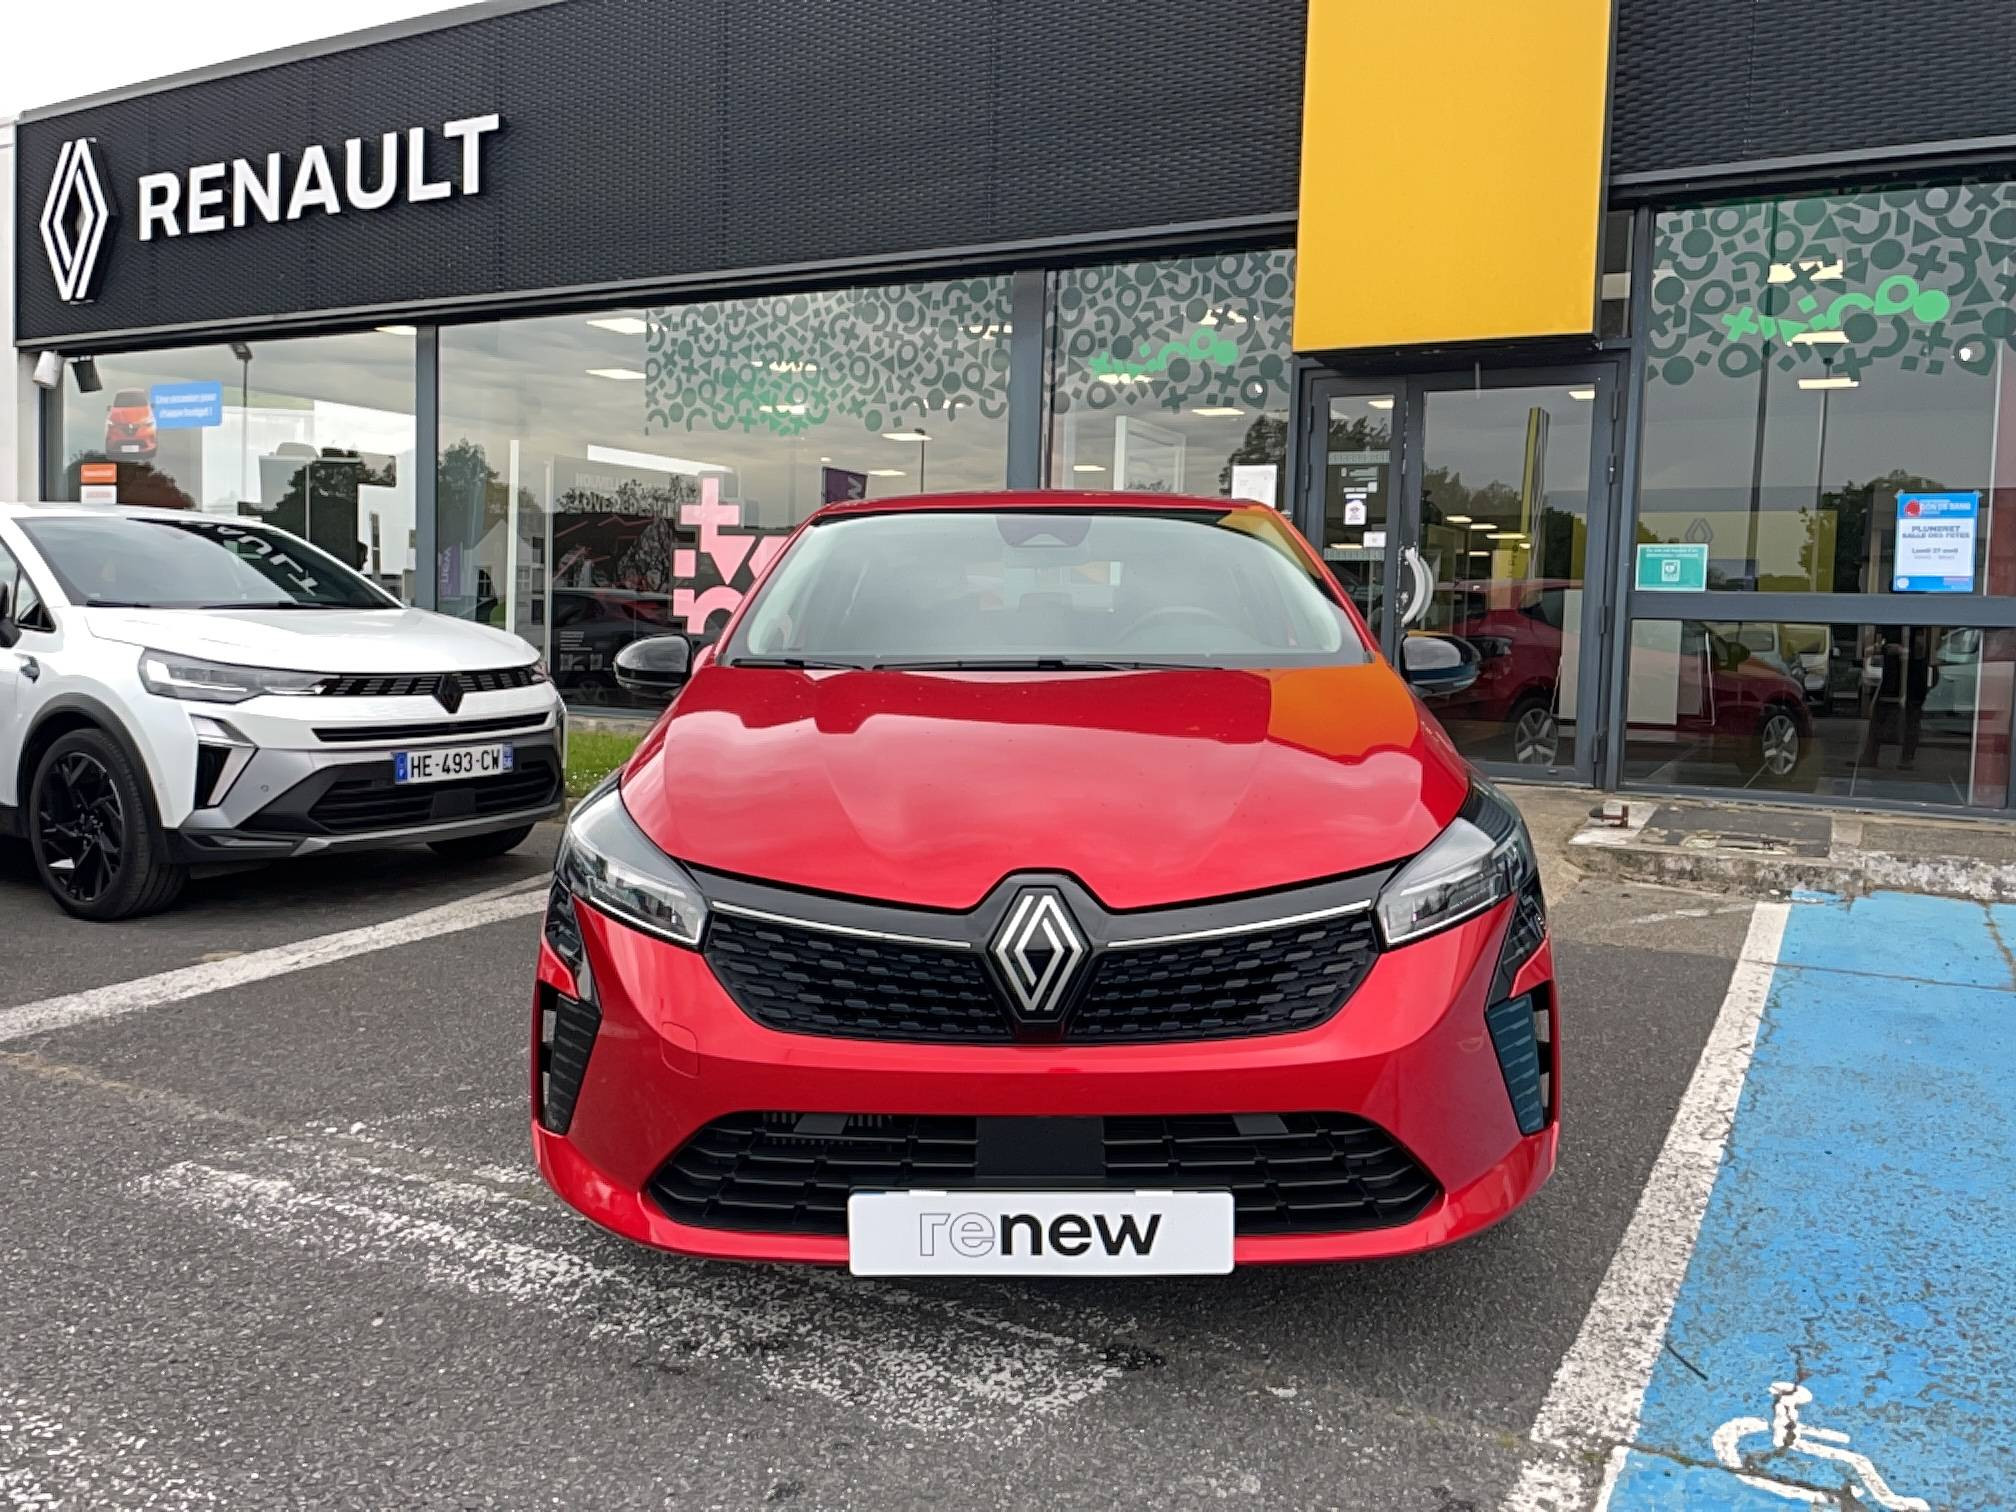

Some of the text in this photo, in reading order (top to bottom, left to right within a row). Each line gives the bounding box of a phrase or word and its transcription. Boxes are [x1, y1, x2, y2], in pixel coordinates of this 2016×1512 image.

[138, 113, 500, 241] RENAULT
[411, 748, 500, 778] HE-493-CW
[918, 1211, 1162, 1258] renew
